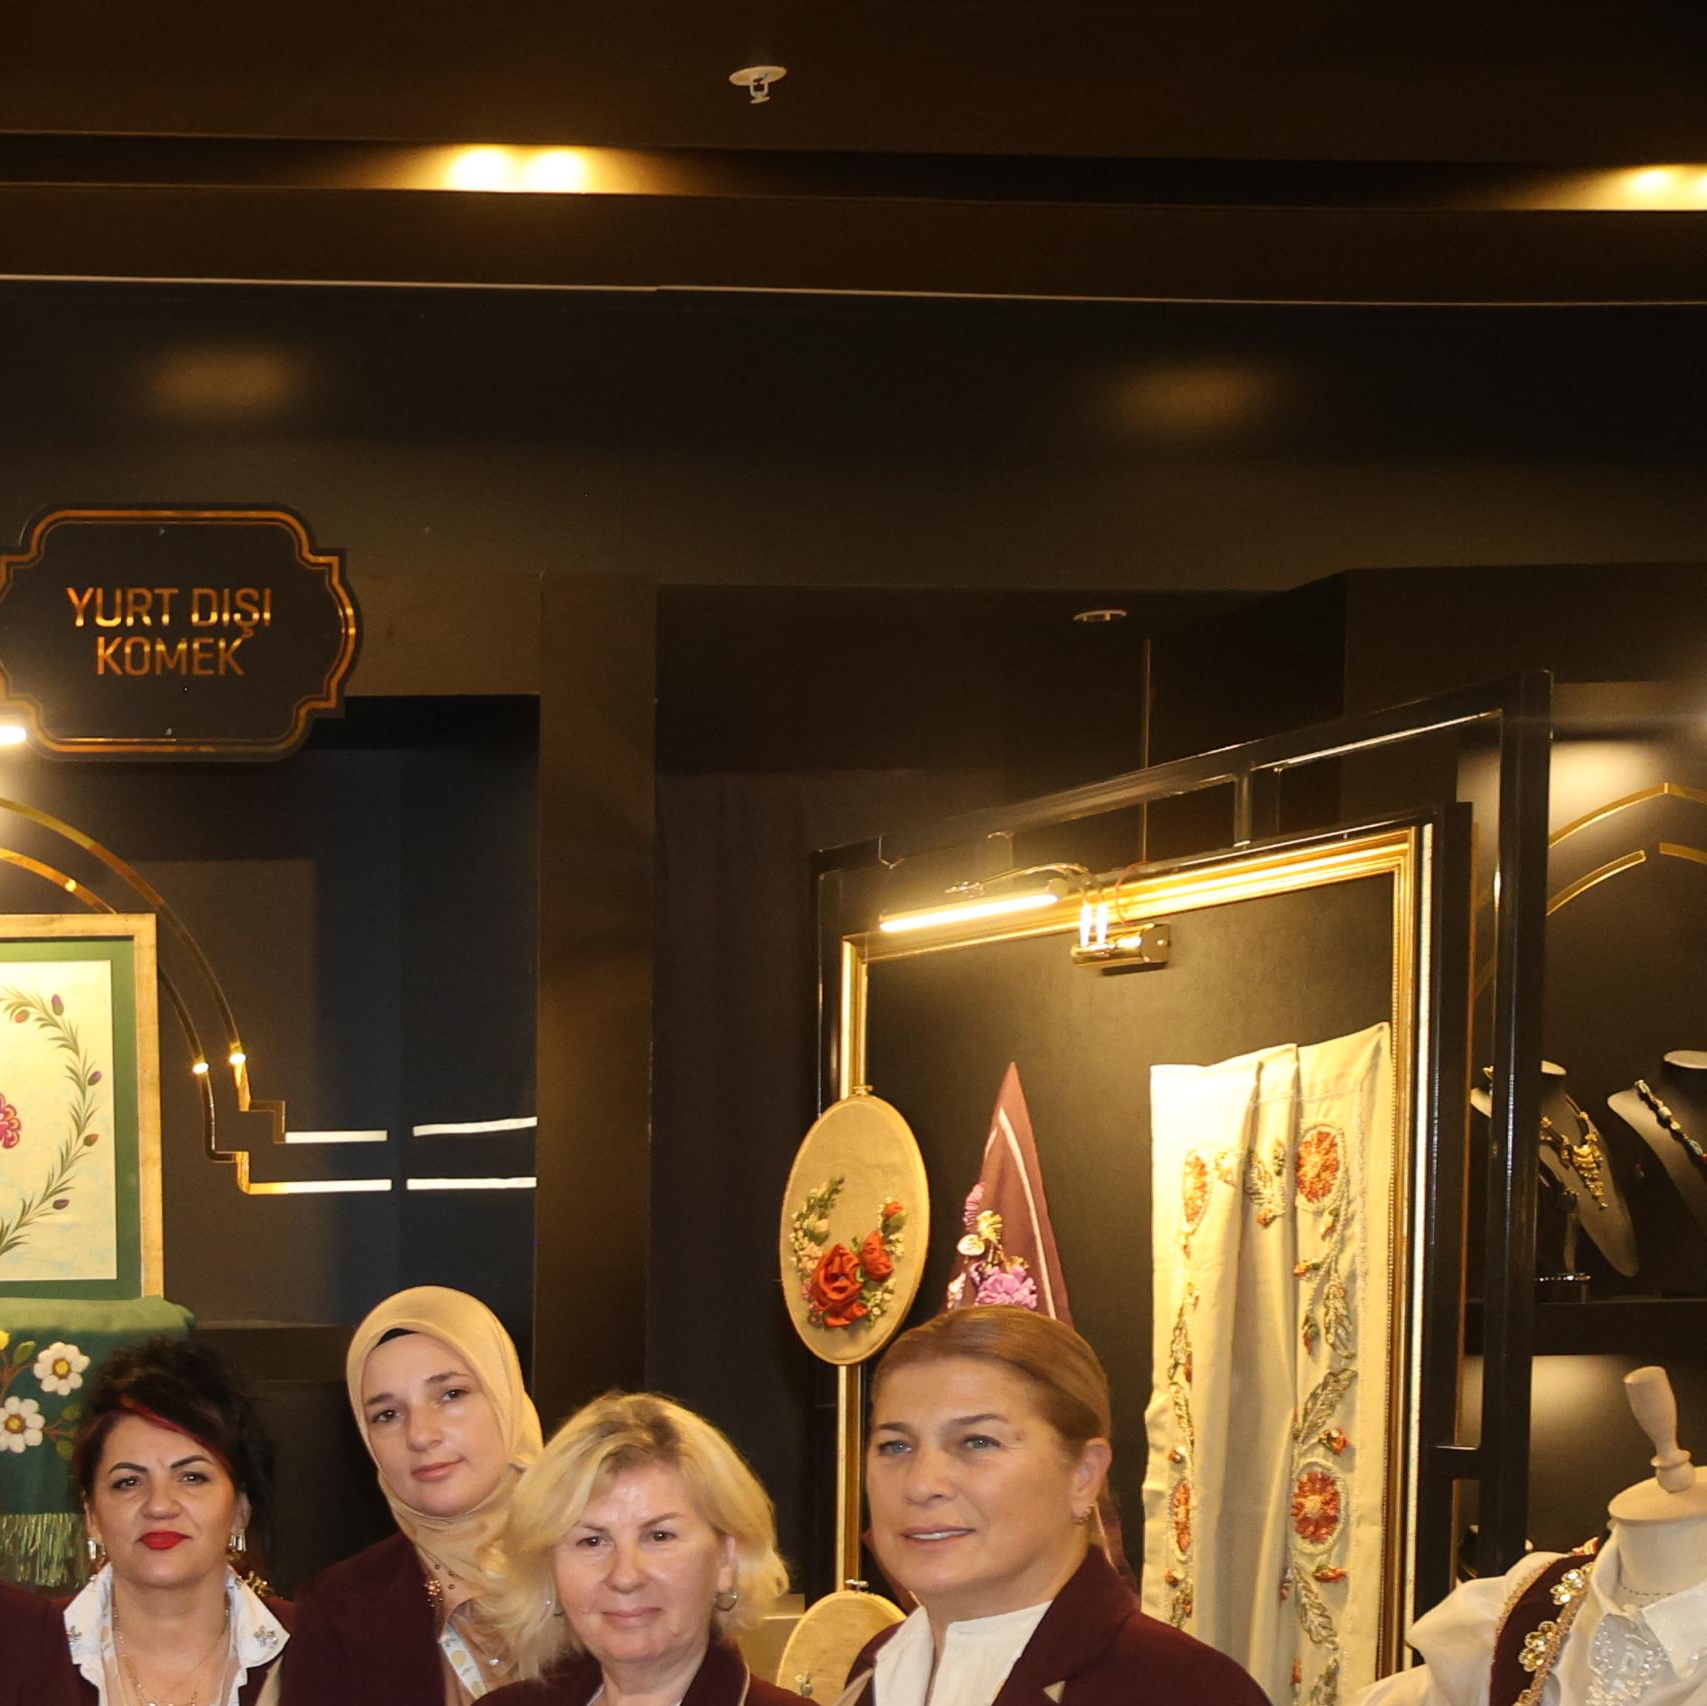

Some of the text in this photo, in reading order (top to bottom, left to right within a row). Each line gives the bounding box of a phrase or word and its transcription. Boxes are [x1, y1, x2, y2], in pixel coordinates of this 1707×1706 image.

[66, 586, 272, 638] YURT DIŞI
[96, 636, 246, 677] KOMEK
